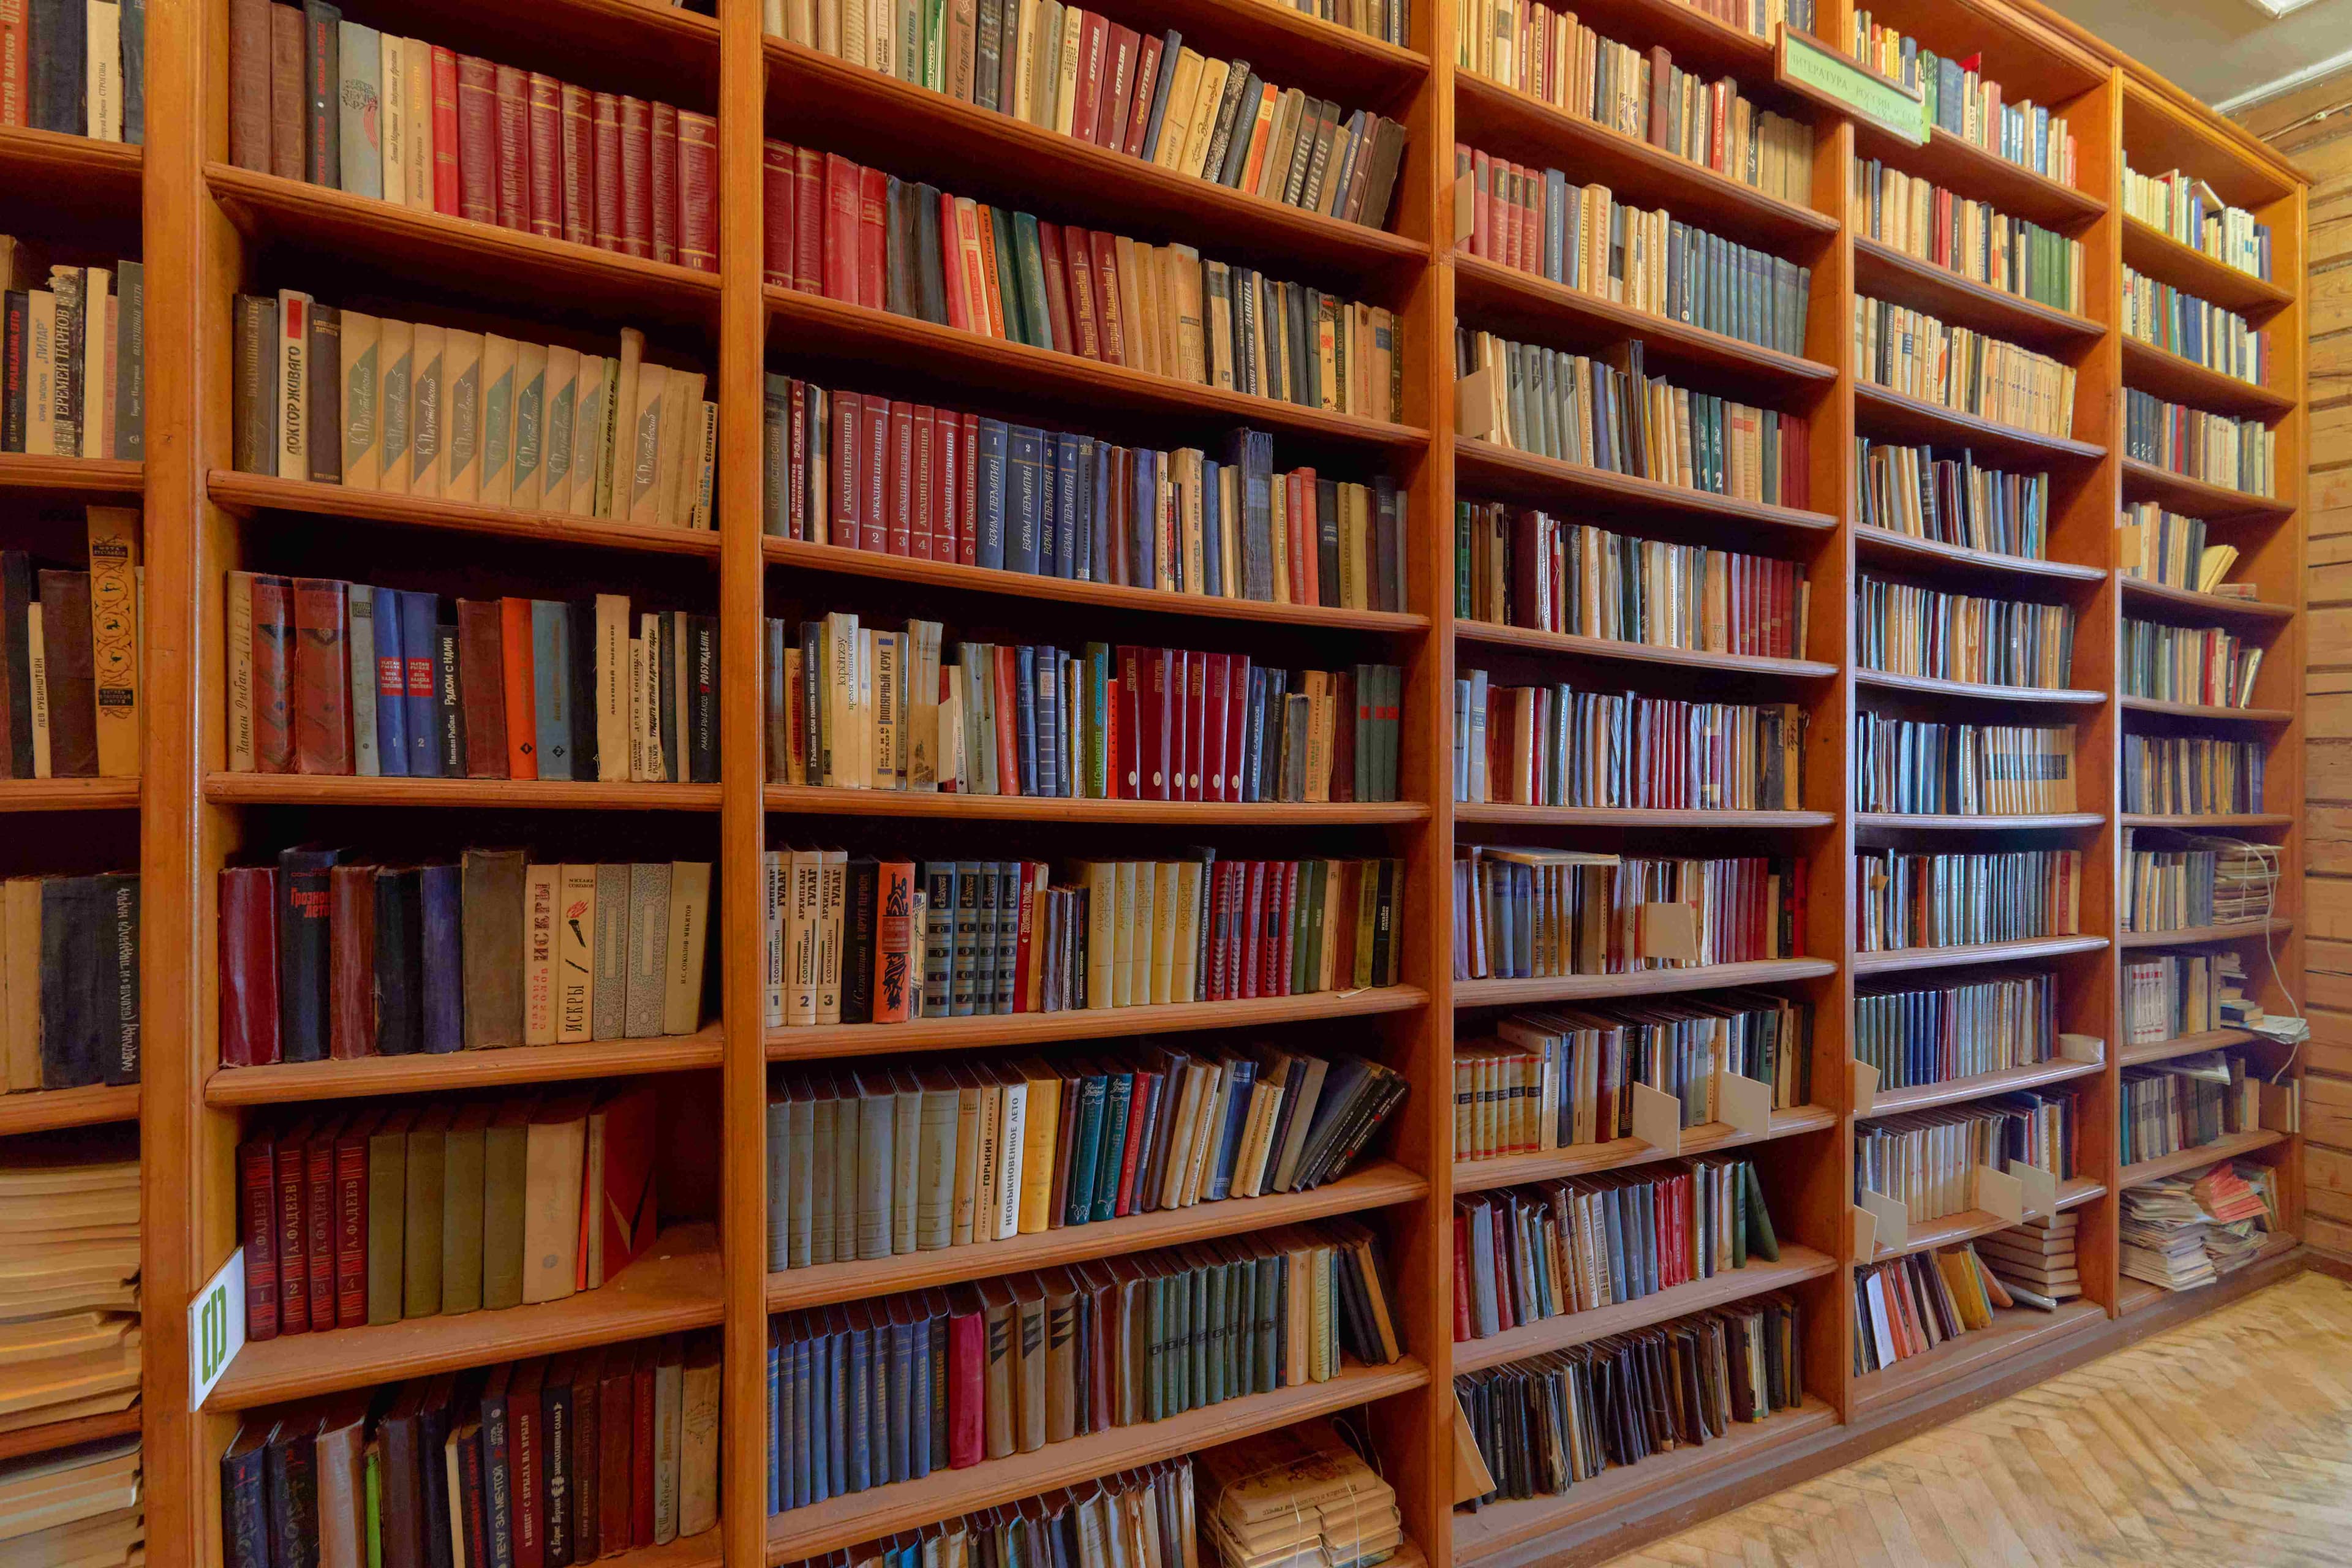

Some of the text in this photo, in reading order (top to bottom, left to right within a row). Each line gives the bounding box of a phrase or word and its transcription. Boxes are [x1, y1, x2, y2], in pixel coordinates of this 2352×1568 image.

[4, 33, 16, 78] МАРКОВ
[1114, 43, 1127, 96] КРУТИЛИН
[1139, 48, 1155, 100] КРУТИЛИН
[984, 235, 996, 285] ОТКРЫТЫЙ
[1076, 270, 1097, 355] Григорий Медынский
[1103, 271, 1120, 356] Григорий Медынский
[53, 308, 70, 417] ЕРЕМЕЙ ПАРНОВ
[286, 405, 302, 456] ДОКТОР
[415, 374, 437, 454] К. Паустовский
[636, 408, 658, 471] Паустовский
[703, 404, 715, 462] СКИТАНИЙ
[843, 412, 853, 514] АРКАДИЙ ПЕРВЕНЦЕВ
[872, 419, 883, 519] АРКАДИЙ ПЕРВЕНЦЕВ
[899, 424, 910, 523] АРКАДИЙ ПЕРВЕНЦЕВ
[919, 428, 930, 527] АРКАДИЙ ПЕРВЕНЦЕВ
[943, 432, 954, 530] АРКАДИЙ ПЕРВЕНЦЕВ
[967, 435, 976, 488] ПЕРВЕНЦЕВ
[1714, 471, 1723, 488] 2
[989, 459, 1000, 548] ЕФИМ ПЕРМИТИН
[1022, 466, 1033, 551] ЕФИМ ПЕРМИТИН
[1043, 470, 1054, 556] ЕФИМ ПЕРМИТИН
[1063, 474, 1074, 559] ЕФИМ ПЕРМИТИН
[844, 528, 851, 538] 1
[872, 532, 880, 543] 2
[899, 536, 907, 546] 3
[919, 540, 927, 550] 4
[942, 542, 950, 553] 5
[966, 545, 974, 556] 6
[35, 657, 47, 728] ЛЕВ РУБИНШТЕЙН
[234, 669, 250, 710] Рыбак
[847, 684, 857, 711] время
[877, 649, 892, 721] ПОЛЯРНЫЙ КРУГ
[237, 715, 250, 756] Натан
[446, 714, 456, 739] Рыбак
[700, 696, 709, 726] РЫБАКОВ
[418, 737, 428, 747] 2
[447, 739, 458, 764] Натан
[700, 727, 709, 750] МАКАР
[769, 868, 777, 921] АРХИПЕЛАГ
[776, 868, 787, 907] ГУЛАГ
[798, 868, 807, 921] АРХИПЕЛАГ
[806, 868, 818, 907] ГУЛАГ
[821, 868, 831, 921] АРХИПЕЛАГ
[831, 868, 842, 907] ГУЛАГ
[1201, 863, 1212, 942] РАССКАЗЫ НАТУРАЛИСТА
[533, 882, 550, 962] ИСКРЫ
[565, 984, 584, 1033] ИСКРЫ
[773, 995, 779, 1006] 1
[800, 995, 809, 1008] 2
[823, 995, 834, 1007] 3
[1262, 1091, 1277, 1144] ПОСЛЕДНИЙ КОСТЕР
[982, 1138, 993, 1186] ГОРЬКИЙ
[1005, 1097, 1020, 1226] НЕОБЫКНОВЕННОЕ ЛЕТО
[285, 1184, 300, 1254] А. ФАДЕЕВ
[313, 1184, 329, 1253] А. ФАДЕЕВ
[344, 1180, 360, 1248] А. ФАДЕЕВ
[521, 1415, 530, 1448] КРЫЛО
[522, 1449, 530, 1463] НА
[522, 1464, 532, 1499] КРЫЛА
[492, 1510, 505, 1526] ЗА
[524, 1512, 533, 1539] ШЕЛЕСТ
